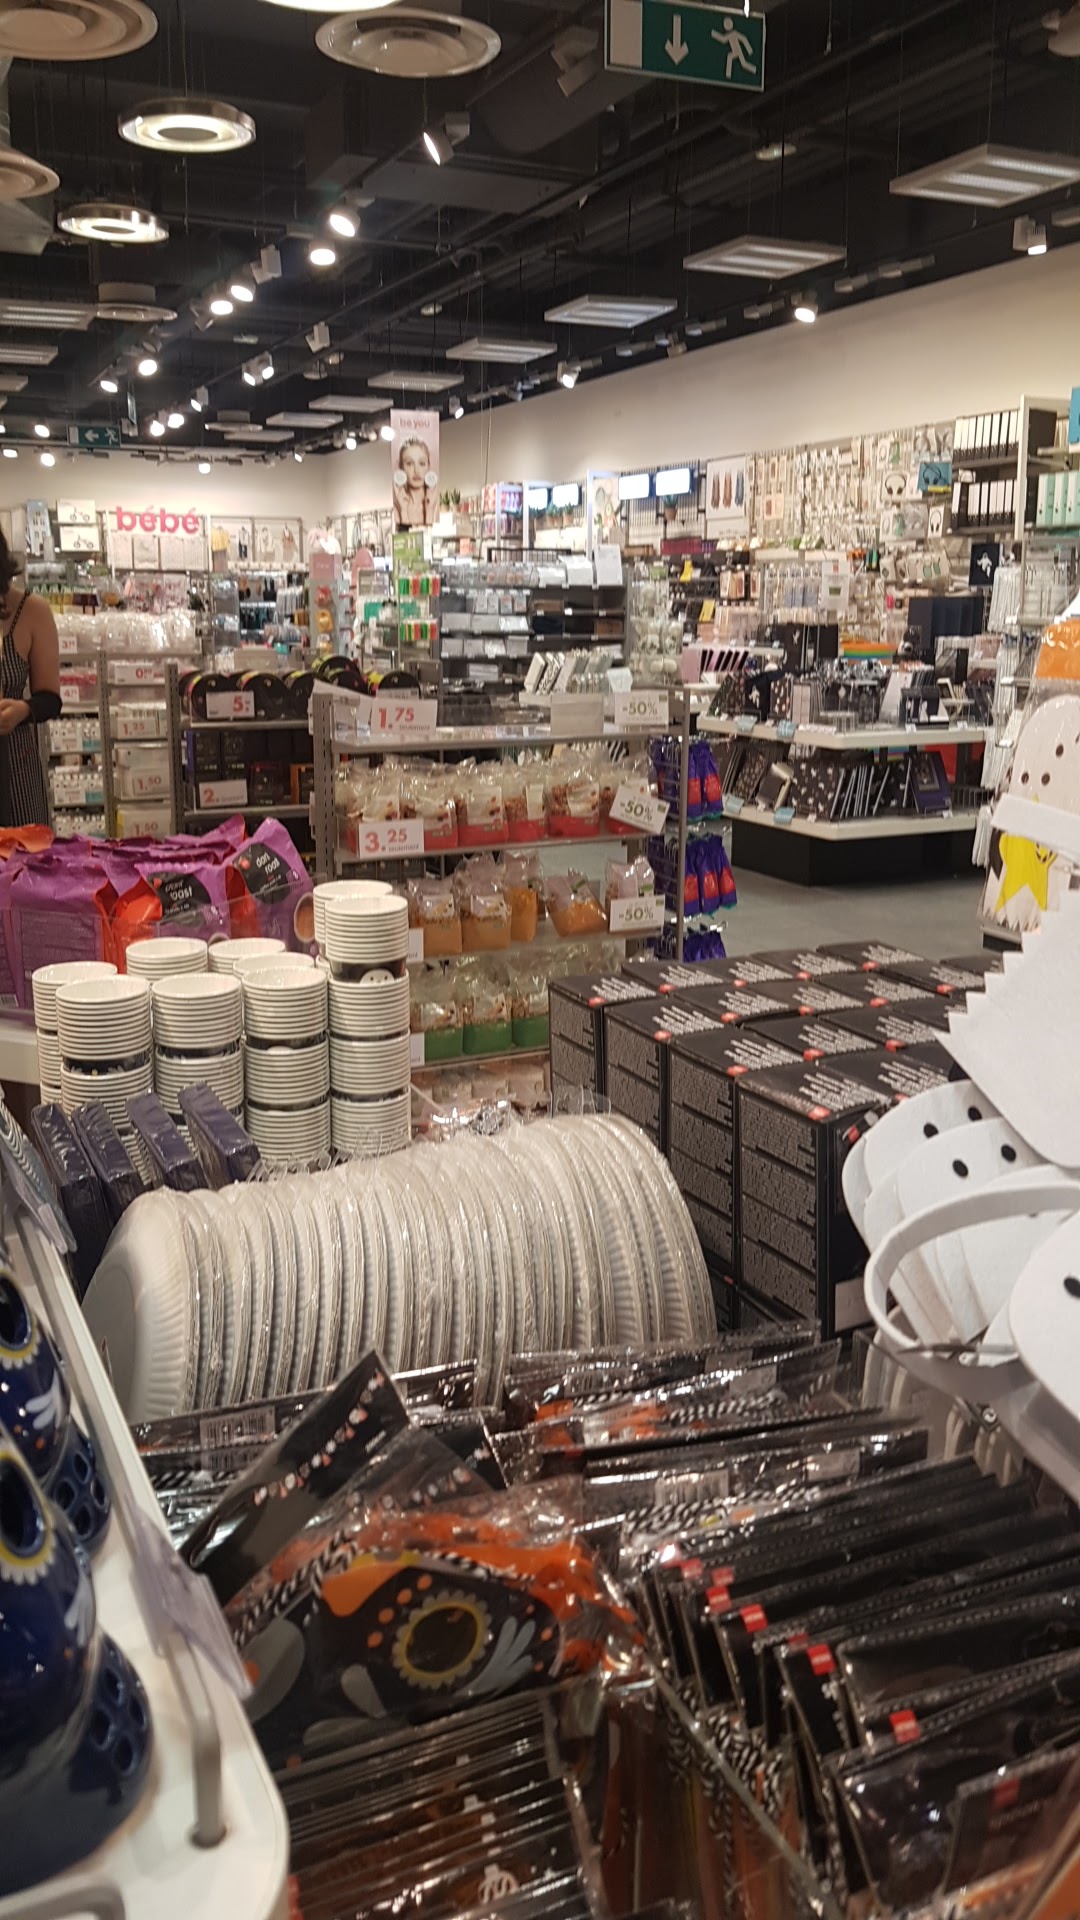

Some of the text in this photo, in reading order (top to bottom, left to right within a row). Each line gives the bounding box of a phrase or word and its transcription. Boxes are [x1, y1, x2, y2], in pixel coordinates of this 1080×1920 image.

[116, 505, 199, 535] bébé
[622, 701, 658, 716] -50%
[620, 800, 654, 821] -50%
[618, 905, 654, 922] -50%
